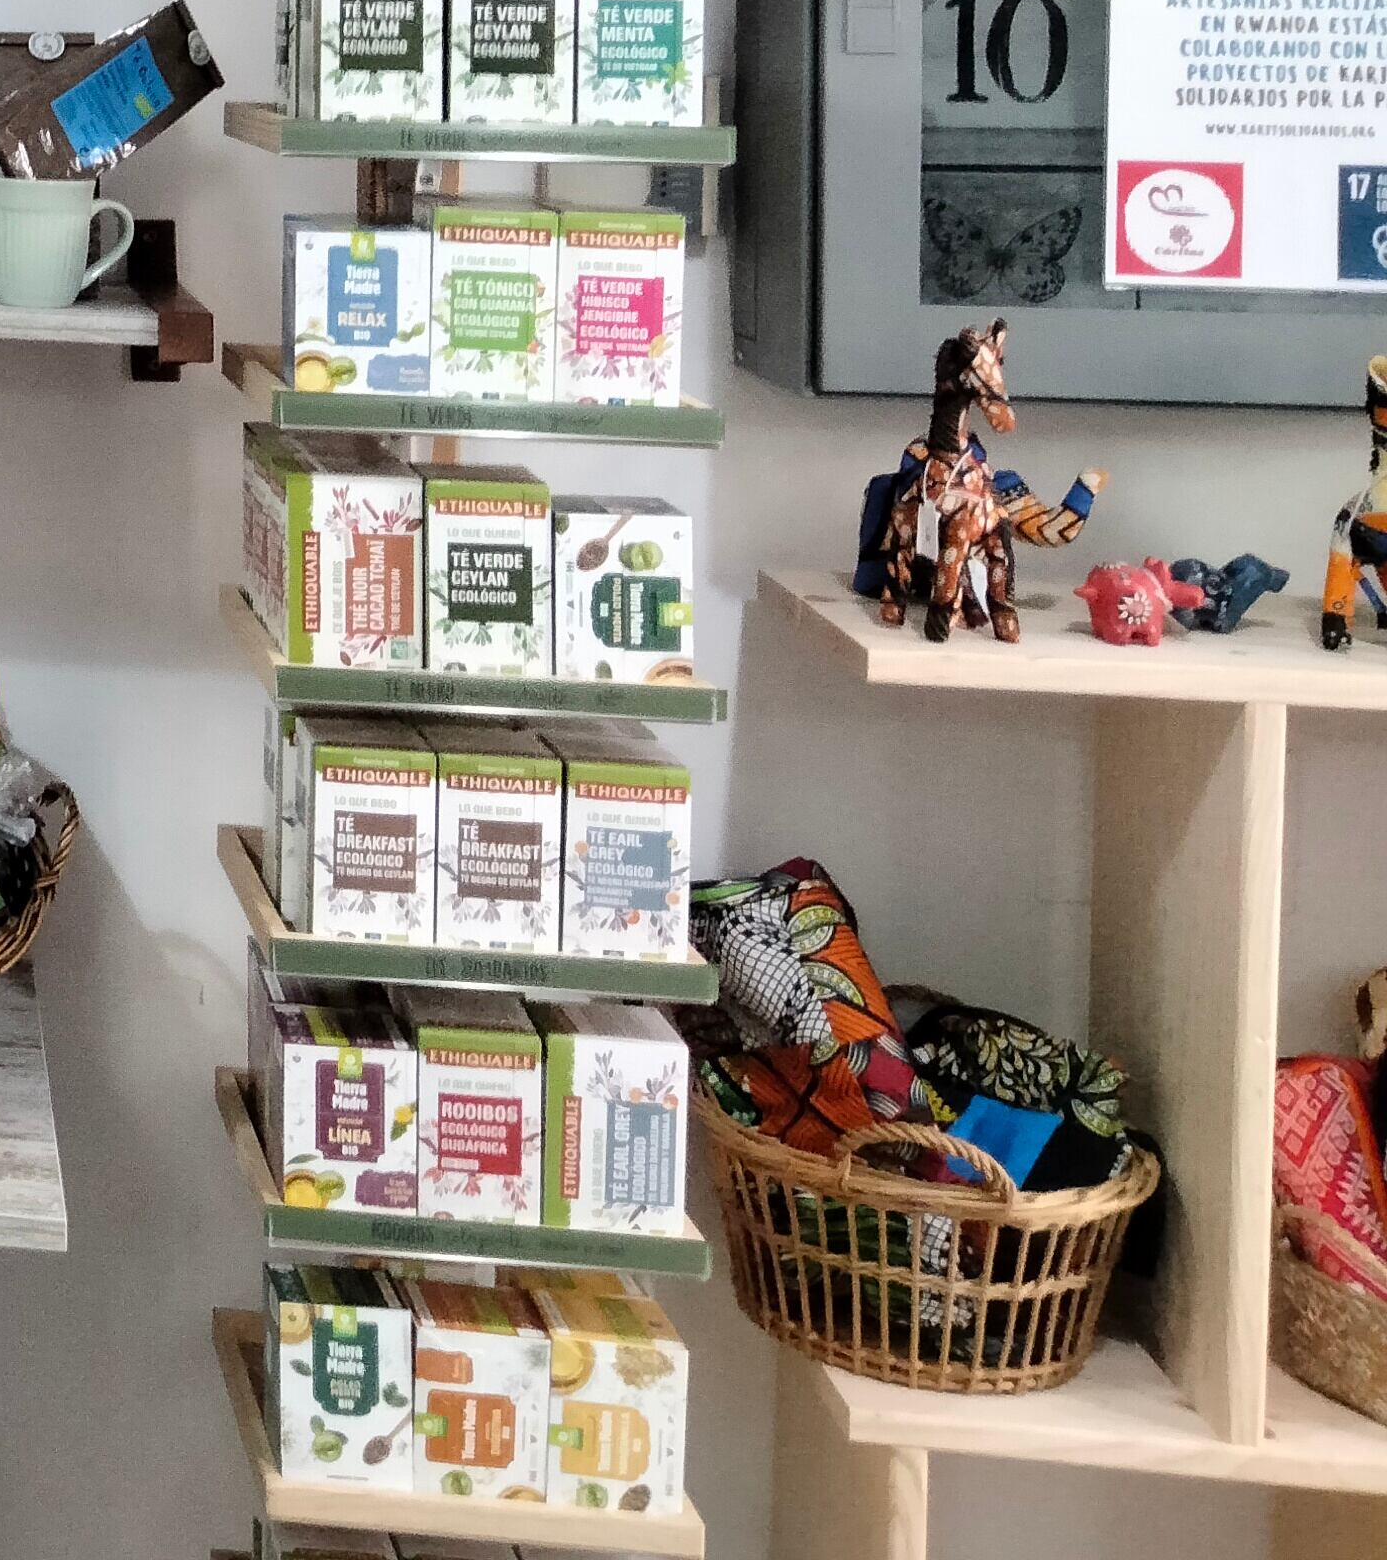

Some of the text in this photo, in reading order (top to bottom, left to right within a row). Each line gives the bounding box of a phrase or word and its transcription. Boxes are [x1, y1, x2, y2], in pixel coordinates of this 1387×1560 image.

[342, 1, 415, 20] TÉ VERDE
[474, 3, 548, 22] TÉ VERDE
[601, 6, 674, 24] TÉ VERDE
[342, 20, 399, 38] CEYLAN
[474, 23, 531, 41] CEYLAN
[601, 25, 655, 42] MENTA
[1199, 15, 1226, 33] EN
[1234, 15, 1320, 35] RWANDA
[601, 43, 668, 60] ECOLÓGICO
[1179, 38, 1368, 60] COLABORANDO CON
[1186, 64, 1297, 84] PROYECTOS
[1305, 65, 1329, 83] DE
[1175, 87, 1365, 109] SOLIDARIOS POR LA
[1347, 172, 1372, 202] 17
[443, 226, 548, 245] ETHIQUABLE
[569, 232, 676, 248] ETHIQUABLE
[454, 276, 535, 297] TÉ TÓNICO
[581, 278, 644, 295] TÉ VERDE
[337, 311, 387, 328] RELAX
[454, 312, 520, 329] ECOLÓGICO
[580, 324, 649, 341] ECOLÓGICO
[439, 498, 543, 518] ETHIQUABLE
[451, 550, 524, 570] TÉ VERDE
[303, 533, 319, 632] ETHIQUABLE
[352, 567, 367, 597] NOIR
[451, 569, 509, 588] CEYLAN
[451, 586, 517, 605] ECOLÓGICO
[368, 586, 385, 632] CACAO
[326, 767, 428, 786] ETHIQUABLE
[450, 774, 554, 794] ETHIQUABLE
[578, 783, 685, 802] ETHIQUABLE
[336, 815, 354, 833] TÉ
[461, 822, 479, 840] TÉ
[336, 834, 415, 854] BREAKFAST
[588, 828, 644, 847] TÉ EARL
[336, 851, 403, 868] ECOLÓGICO
[461, 842, 541, 861] BREAKFAST
[587, 846, 625, 862] GREY
[461, 859, 528, 876] ECOLÓGICO
[588, 862, 654, 880] ECOLÓGICO
[429, 1048, 532, 1069] ETHIQUABLE
[333, 1079, 368, 1097] Tierra
[331, 1095, 369, 1112] Madre
[441, 1101, 519, 1124] ROOIBOS
[328, 1125, 372, 1146] LÍNEA
[440, 1122, 508, 1139] ECOLÓGICO
[440, 1137, 509, 1156] SUDÁFRICA
[565, 1098, 580, 1196] ETHIQUABLE
